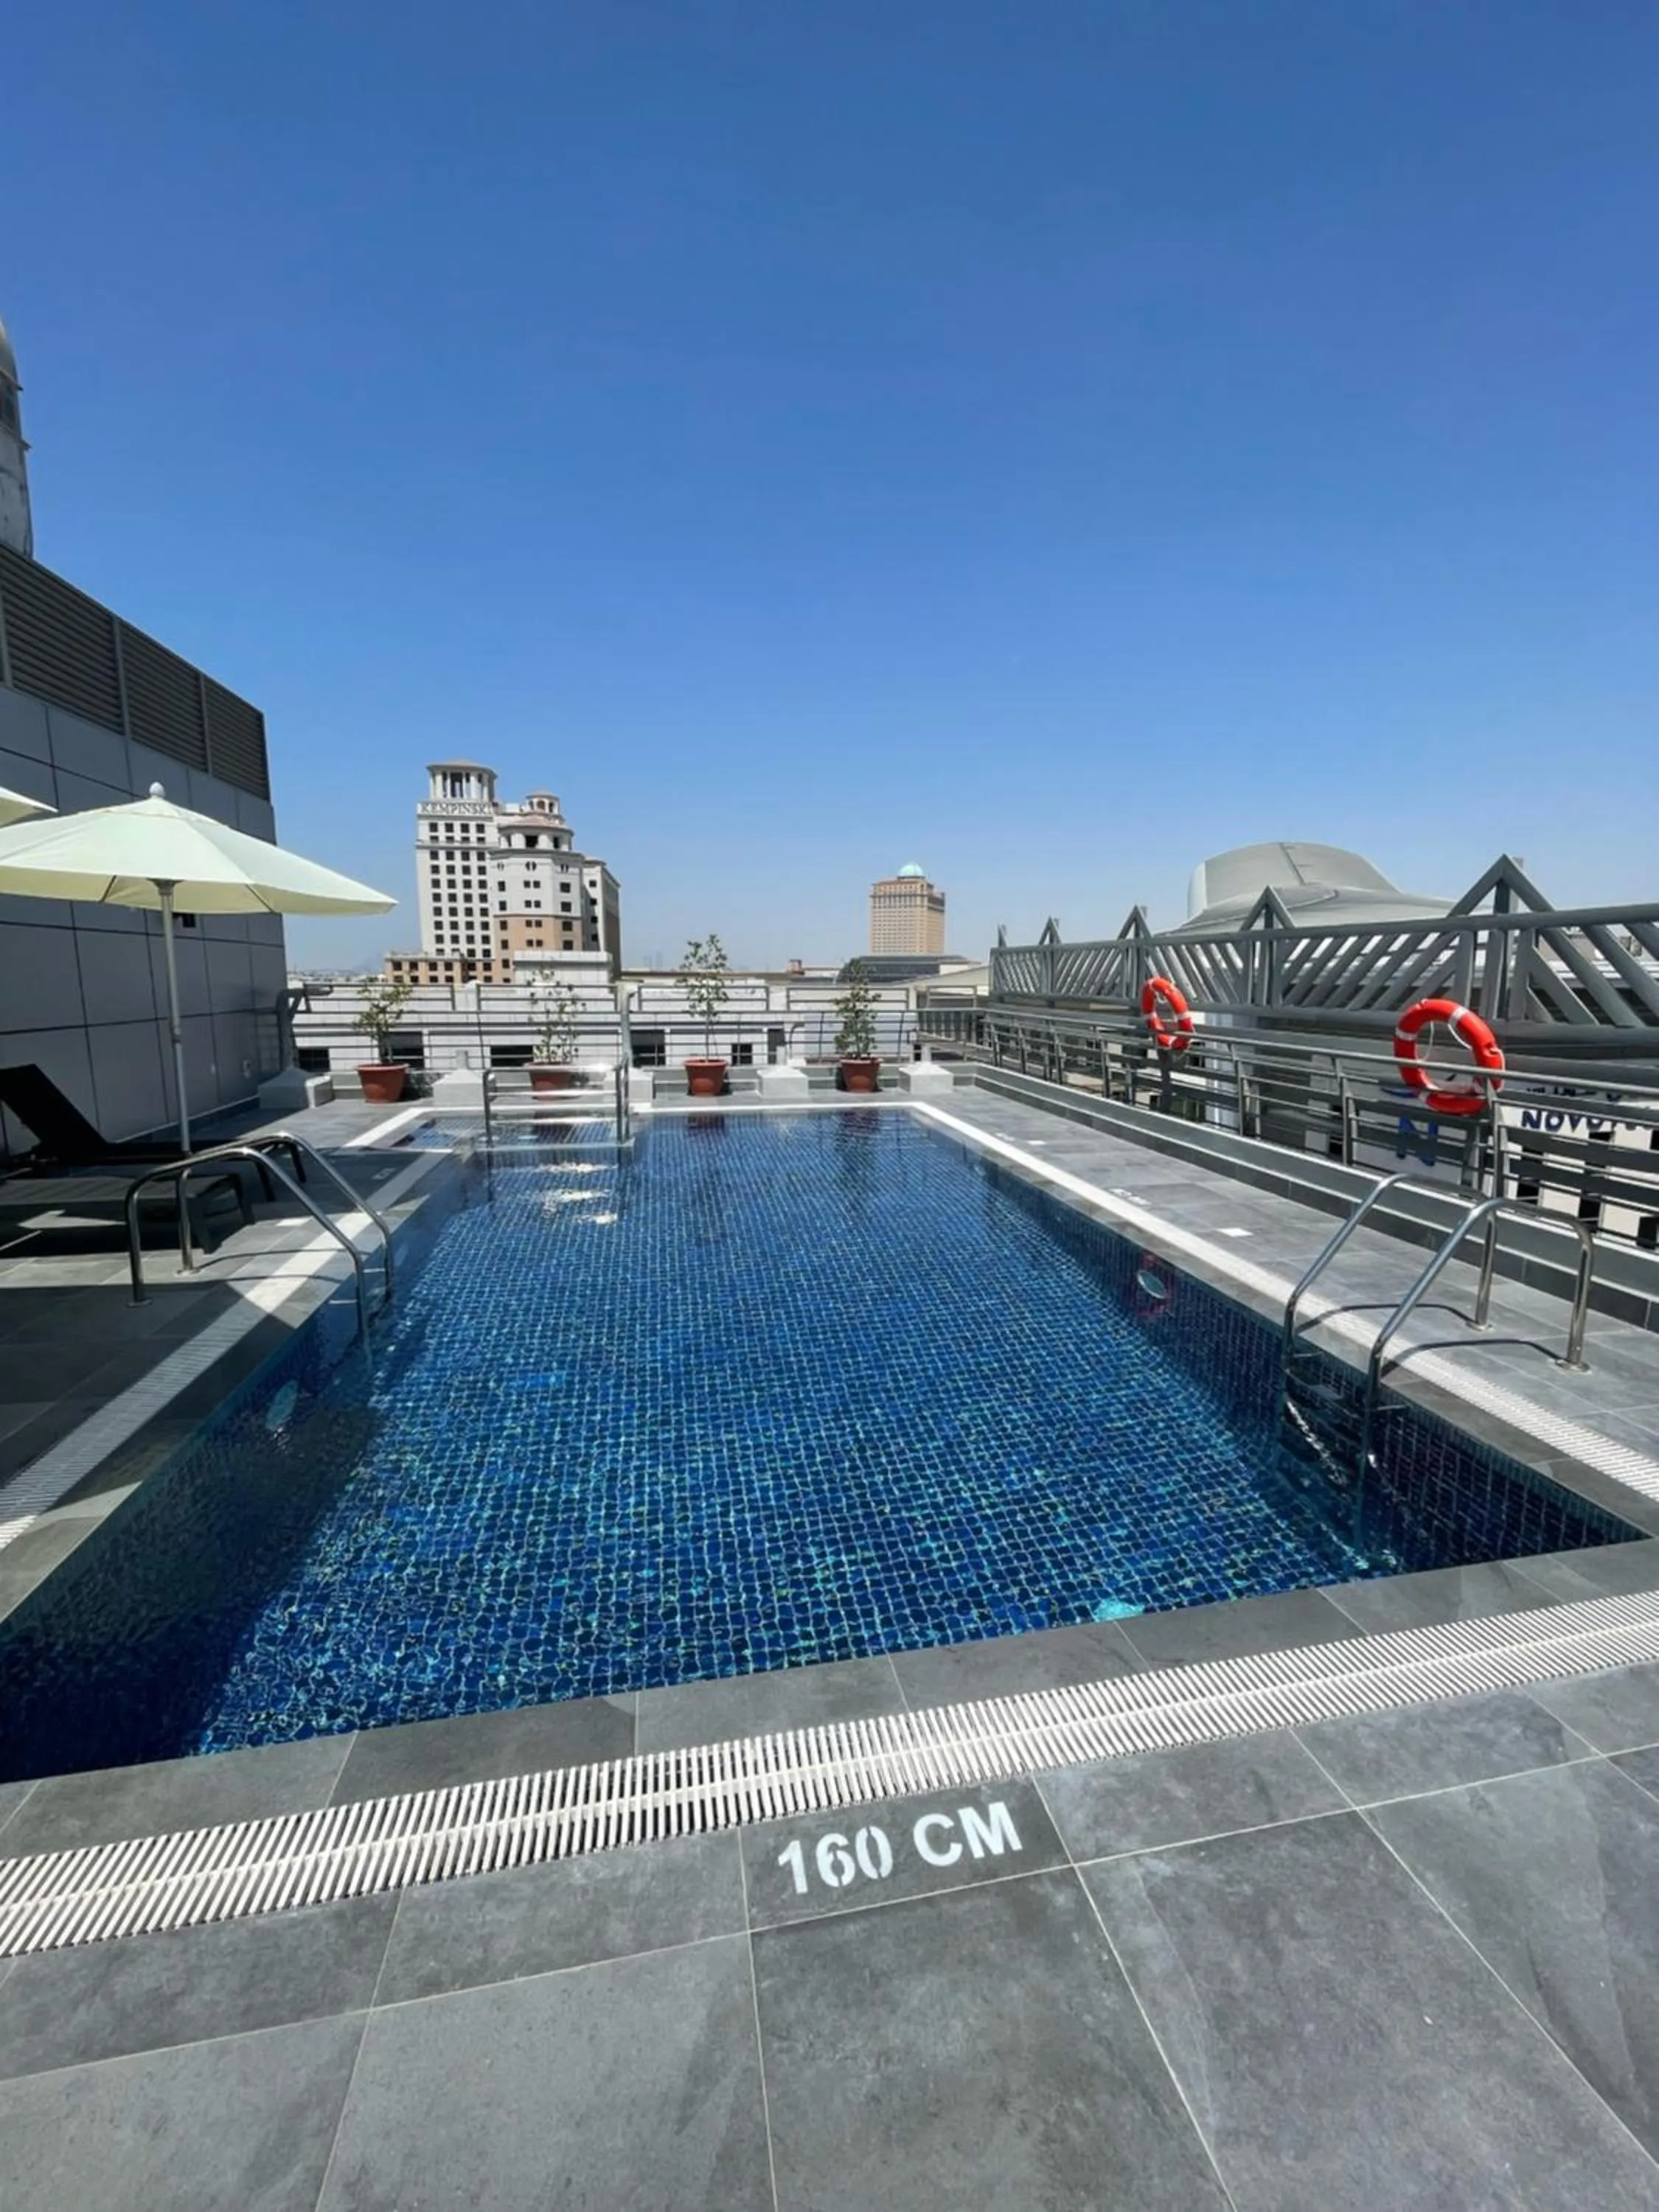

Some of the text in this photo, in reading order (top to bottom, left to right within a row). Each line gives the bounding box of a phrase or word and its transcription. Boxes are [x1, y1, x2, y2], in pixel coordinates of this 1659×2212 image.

[421, 801, 493, 815] KEMPINSKI
[778, 1802, 1023, 1894] 160 CM
